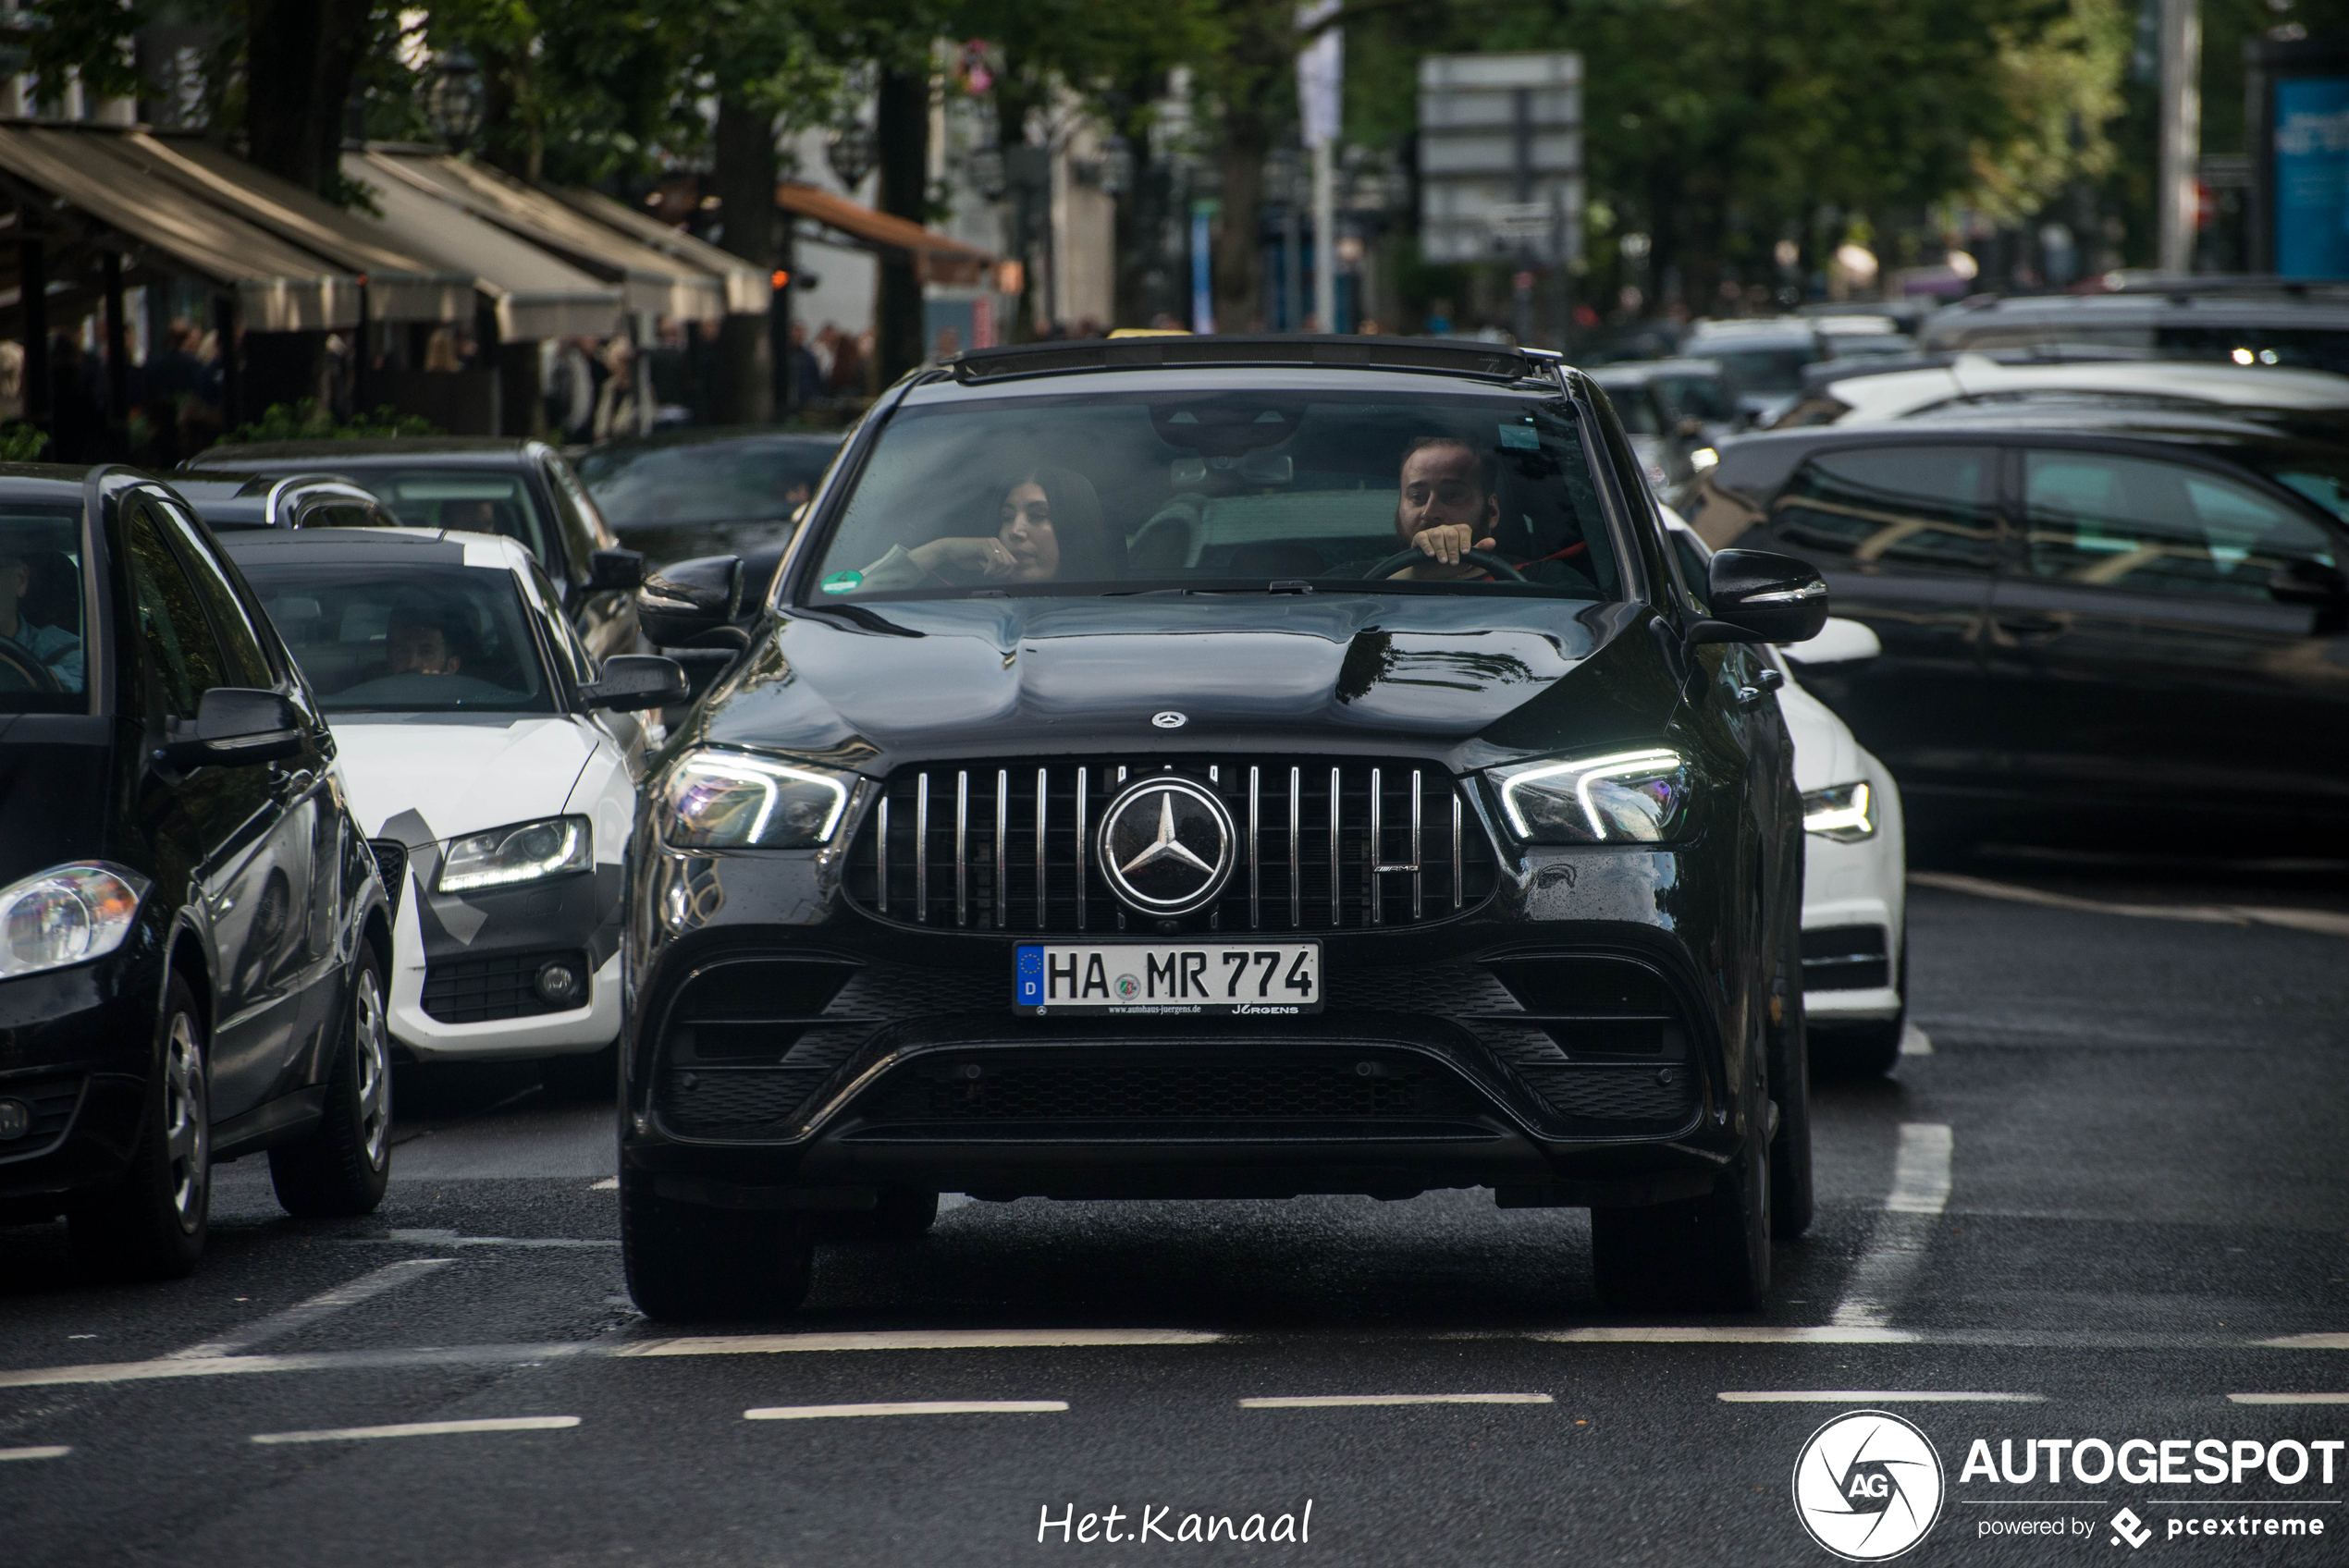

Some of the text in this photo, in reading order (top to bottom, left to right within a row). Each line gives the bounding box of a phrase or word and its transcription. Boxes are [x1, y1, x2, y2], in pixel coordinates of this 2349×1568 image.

[1048, 952, 1110, 999] HA
[1147, 951, 1210, 998] MR
[1223, 950, 1313, 998] 774
[1026, 982, 1037, 996] D
[1108, 1004, 1202, 1016] www.autohaus-juergens.de
